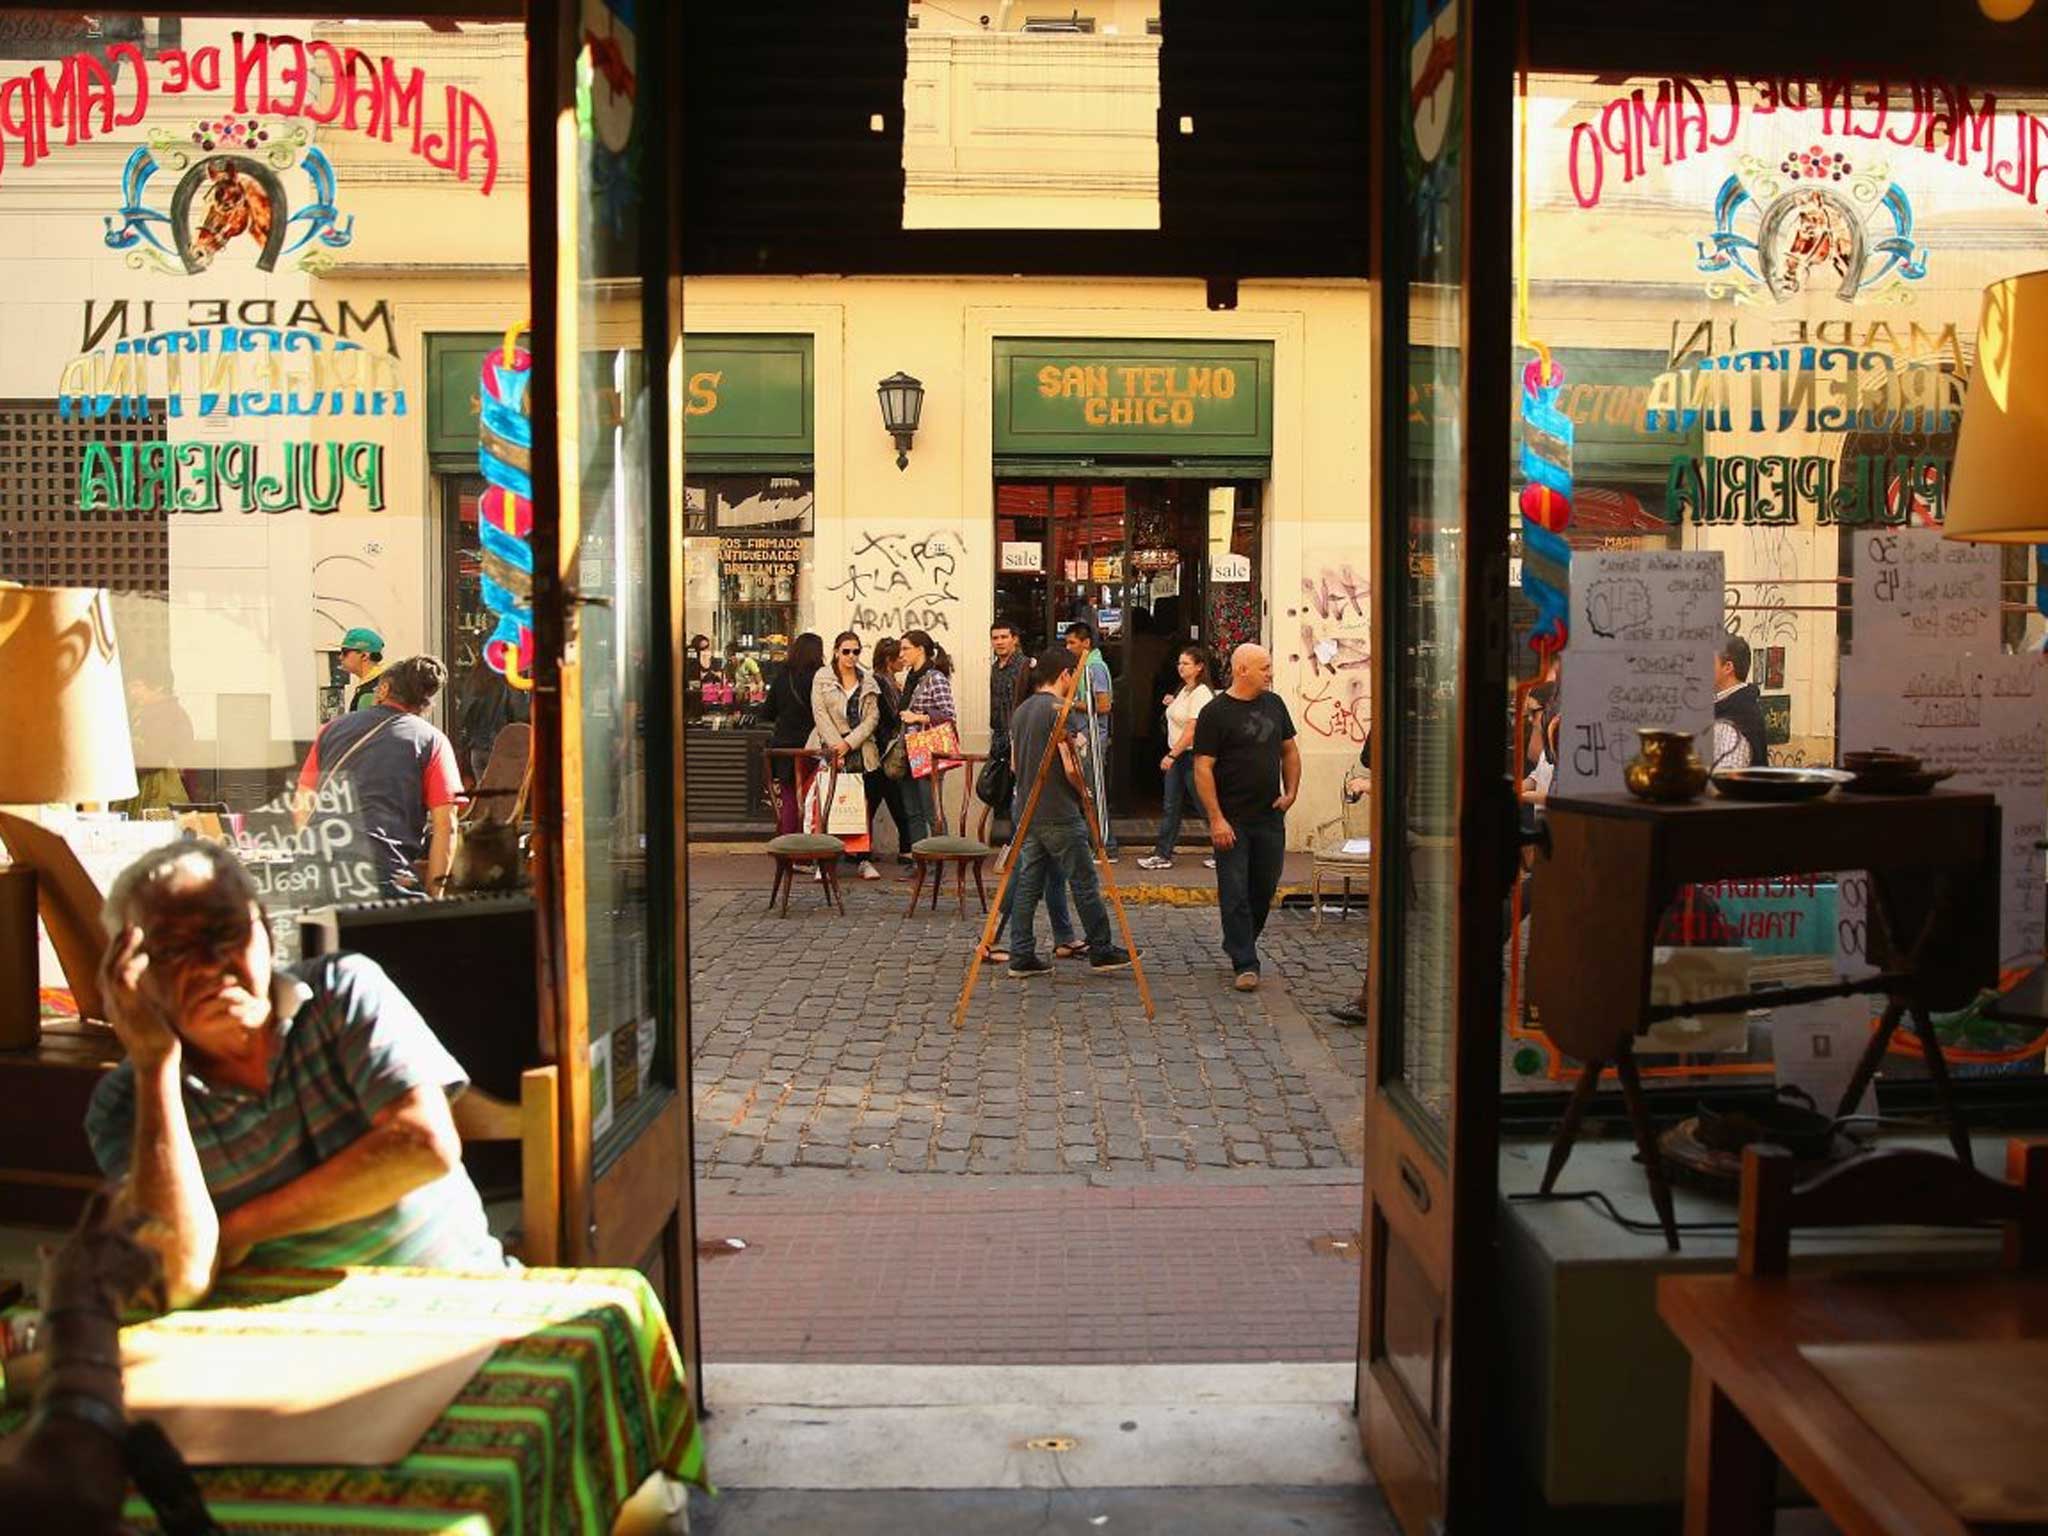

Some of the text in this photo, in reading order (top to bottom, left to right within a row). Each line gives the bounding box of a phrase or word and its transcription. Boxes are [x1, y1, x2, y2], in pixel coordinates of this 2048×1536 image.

[1038, 365, 1236, 400] SAN TELMO
[1084, 399, 1195, 427] CHICO
[1004, 551, 1039, 568] sale
[1214, 562, 1248, 579] sale
[848, 604, 949, 634] ARMADA
